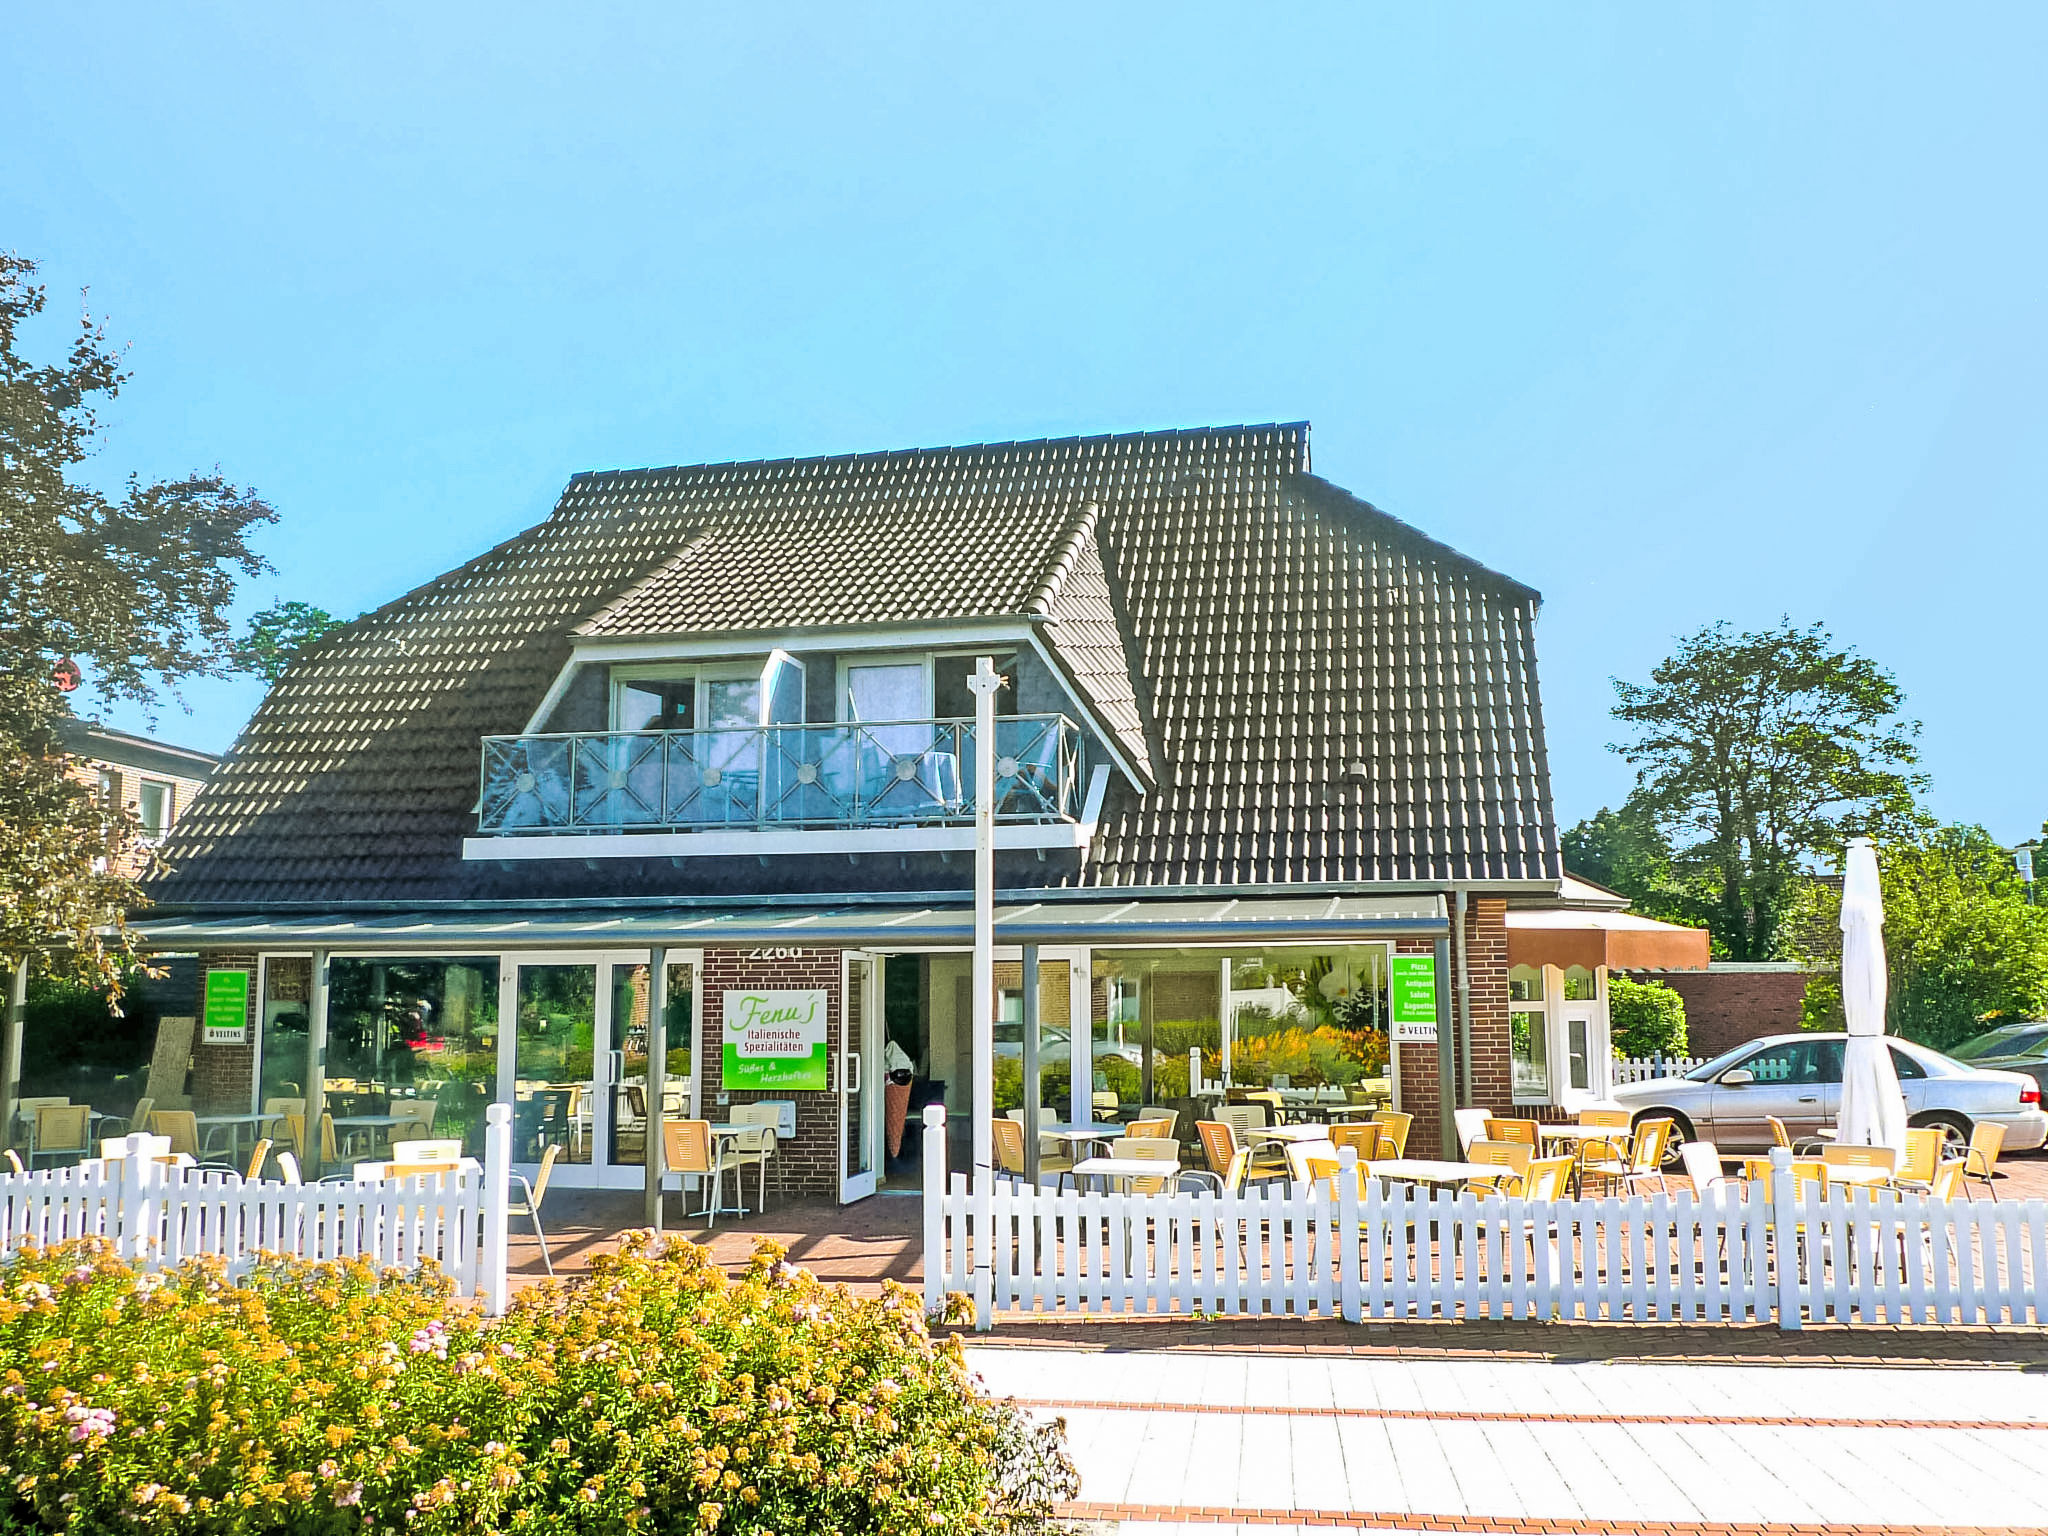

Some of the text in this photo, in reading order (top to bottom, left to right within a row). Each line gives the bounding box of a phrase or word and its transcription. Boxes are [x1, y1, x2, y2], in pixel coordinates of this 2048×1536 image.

[215, 1030, 241, 1038] VELTINS
[747, 1028, 801, 1040] Italienische
[1408, 1026, 1438, 1035] VELTIN
[744, 1041, 804, 1053] Spezialitäten
[768, 1061, 777, 1071] &
